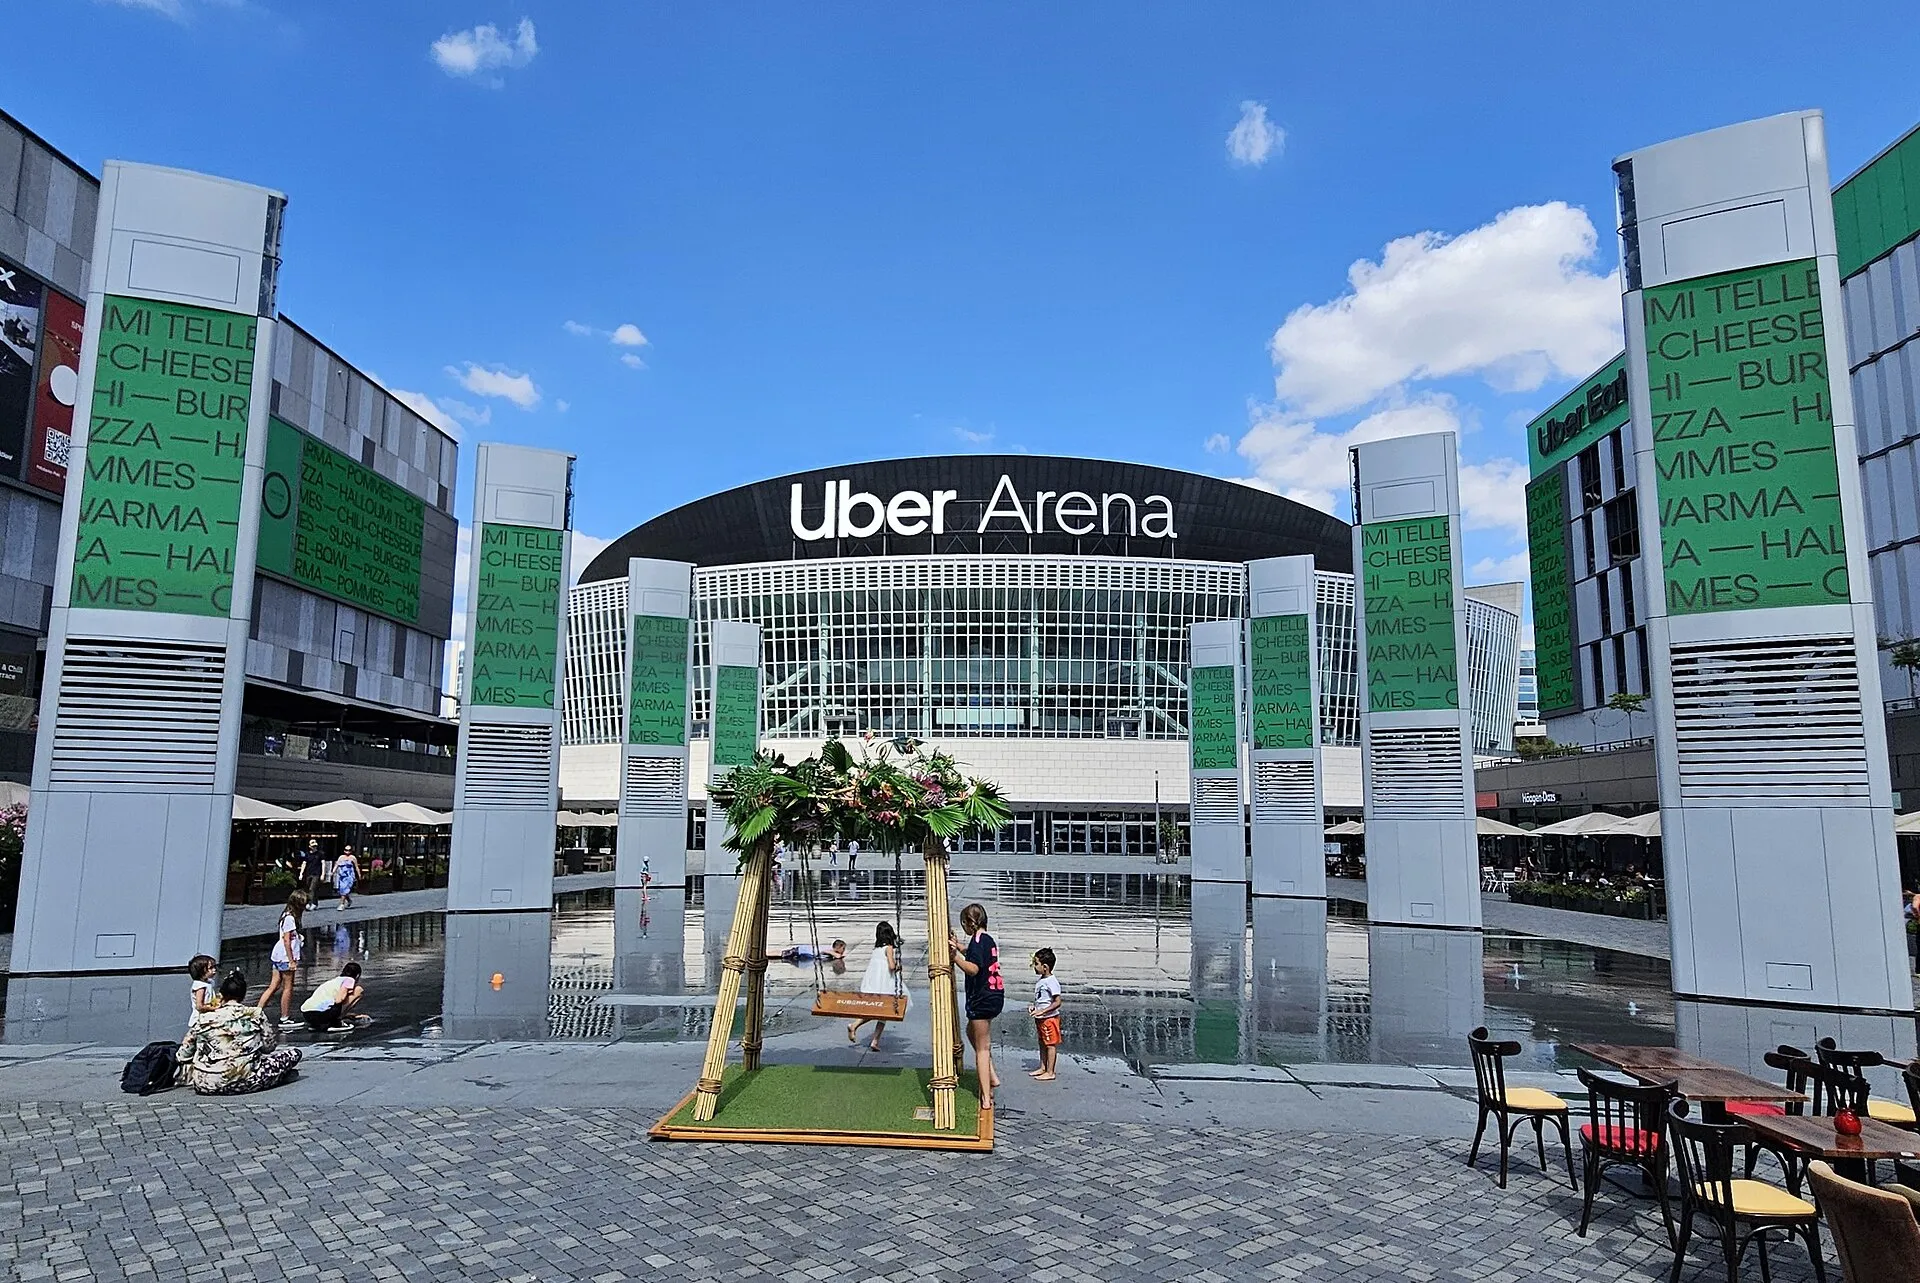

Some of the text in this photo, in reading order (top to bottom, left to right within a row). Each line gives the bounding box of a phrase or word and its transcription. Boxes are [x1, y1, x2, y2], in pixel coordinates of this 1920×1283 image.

[101, 304, 151, 336] MI
[1643, 290, 1696, 325] MI
[1739, 351, 1825, 391] BUR
[175, 388, 247, 422] BUR
[1653, 392, 1831, 442] ZZA H
[90, 416, 246, 458] ZZA H
[1537, 402, 1587, 456] Uber
[339, 481, 392, 525] HALLOUMI
[790, 474, 1178, 541] Uber Arena
[76, 536, 113, 565] A
[329, 524, 360, 553] SUSHI
[373, 544, 410, 576] BURGER
[481, 528, 507, 545] MI
[1362, 528, 1389, 546] MI
[1662, 537, 1700, 568] A
[75, 574, 158, 607] MES
[337, 573, 383, 608] POMMES
[363, 562, 390, 588] PIZZA
[521, 575, 559, 593] BUR
[1409, 568, 1451, 588] BUR
[1669, 573, 1759, 609] MES
[542, 598, 559, 614] H
[1366, 592, 1453, 614] ZZA H
[1369, 669, 1387, 685] A
[1371, 690, 1415, 708] MES
